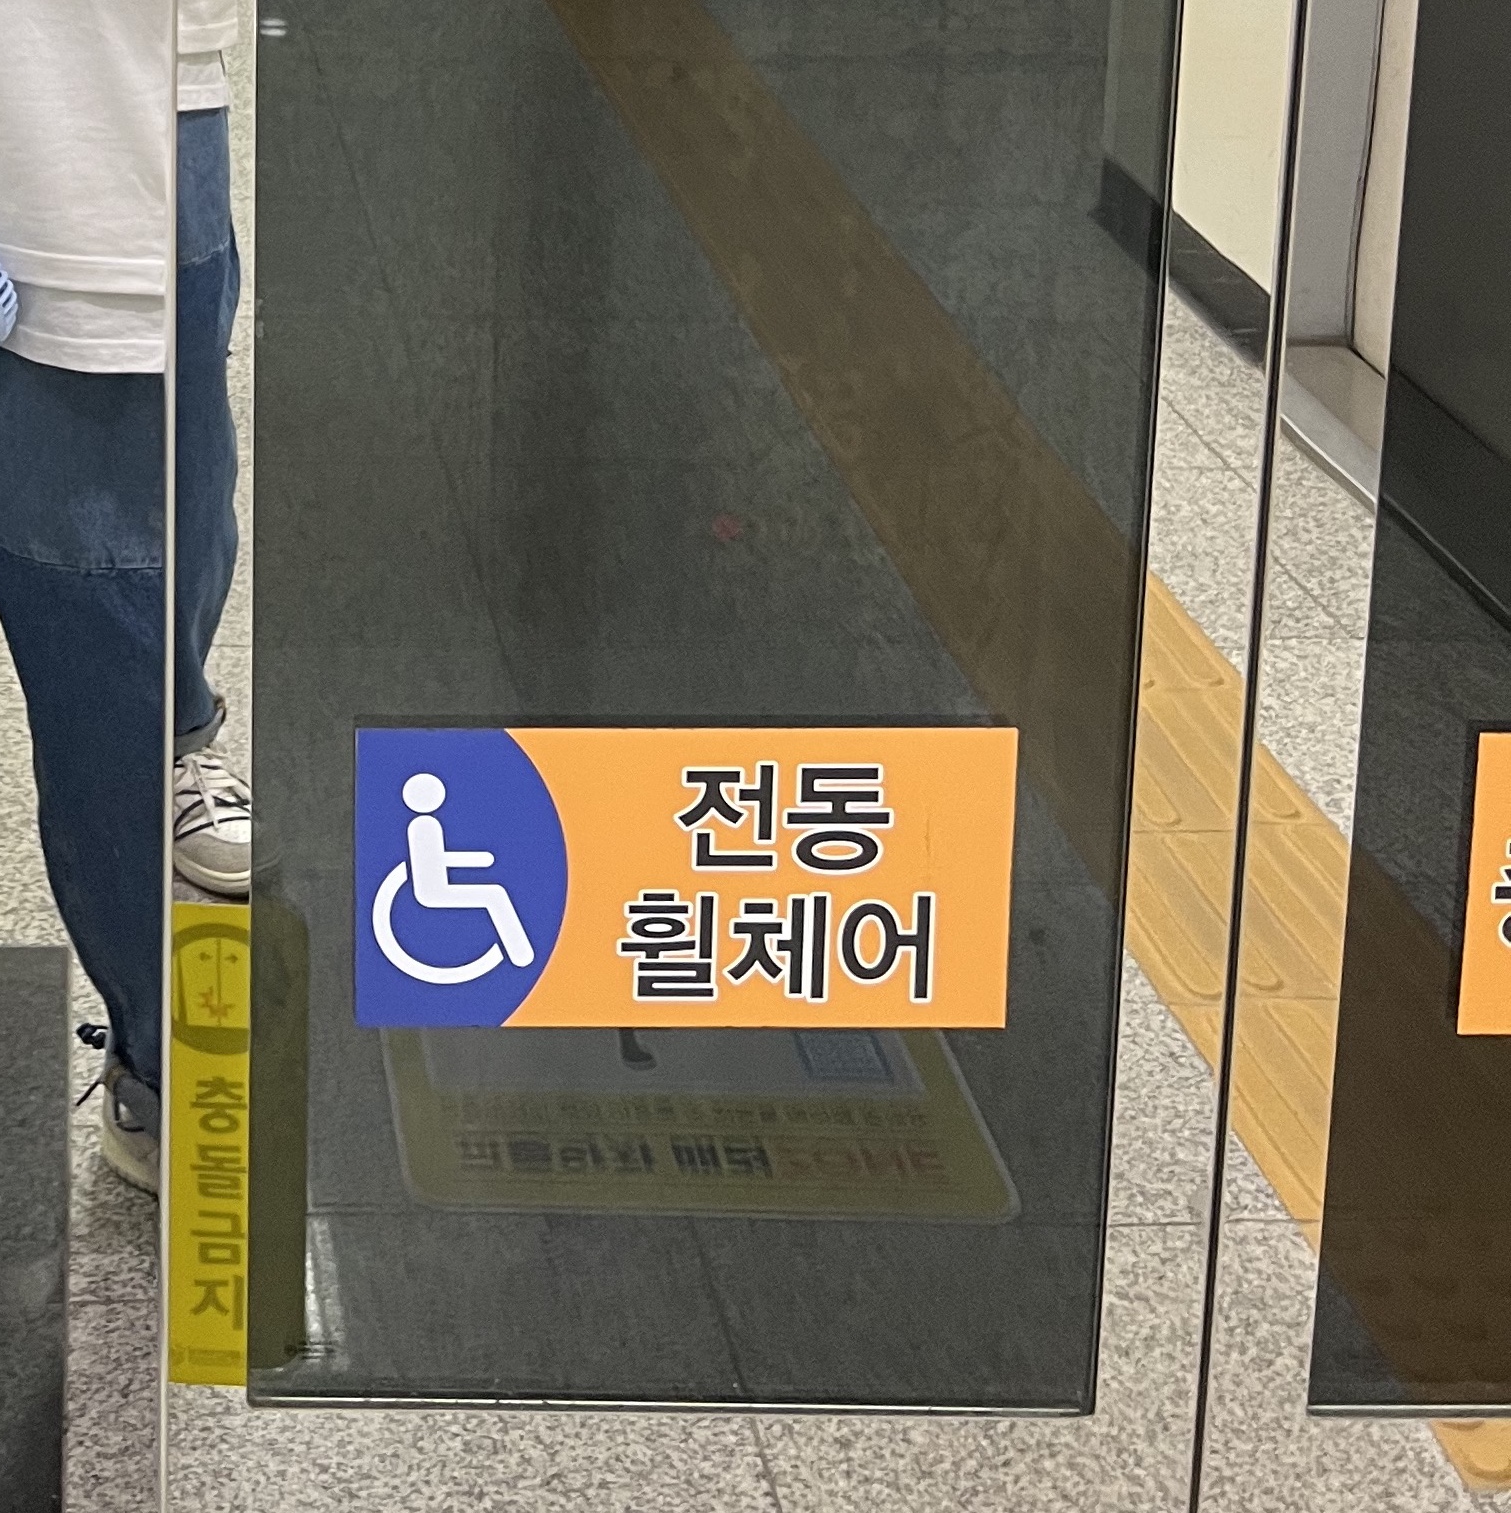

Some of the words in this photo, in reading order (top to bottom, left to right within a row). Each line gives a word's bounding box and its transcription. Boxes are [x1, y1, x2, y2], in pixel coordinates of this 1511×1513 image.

[676, 762, 892, 873] 전동
[618, 891, 935, 1001] 휠체어
[190, 1076, 248, 1331] 충돌금지
